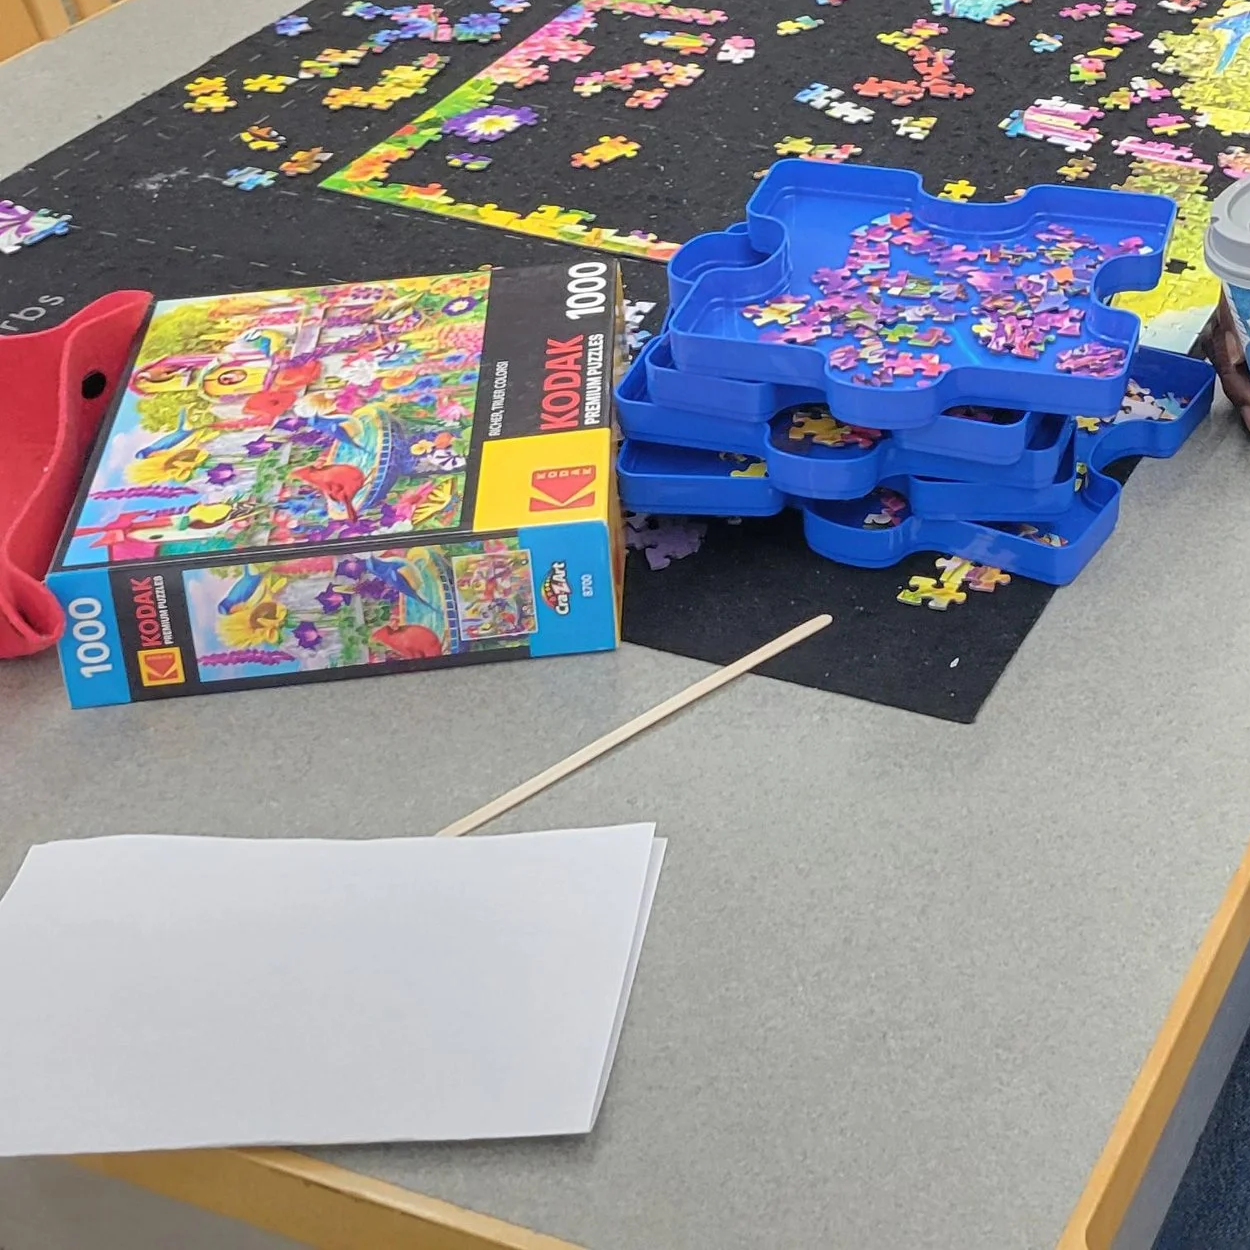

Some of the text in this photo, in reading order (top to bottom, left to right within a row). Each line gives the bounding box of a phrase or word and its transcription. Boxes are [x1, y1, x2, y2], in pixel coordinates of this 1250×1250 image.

[565, 261, 608, 320] 1000
[539, 333, 584, 431] KODAK
[584, 332, 605, 426] PREMIUM PUZZLES
[536, 467, 593, 480] KODAK
[130, 576, 162, 647] KODAK
[153, 575, 168, 610] PUZZLES
[68, 597, 113, 678] 1000
[159, 609, 175, 645] PREMIUM
